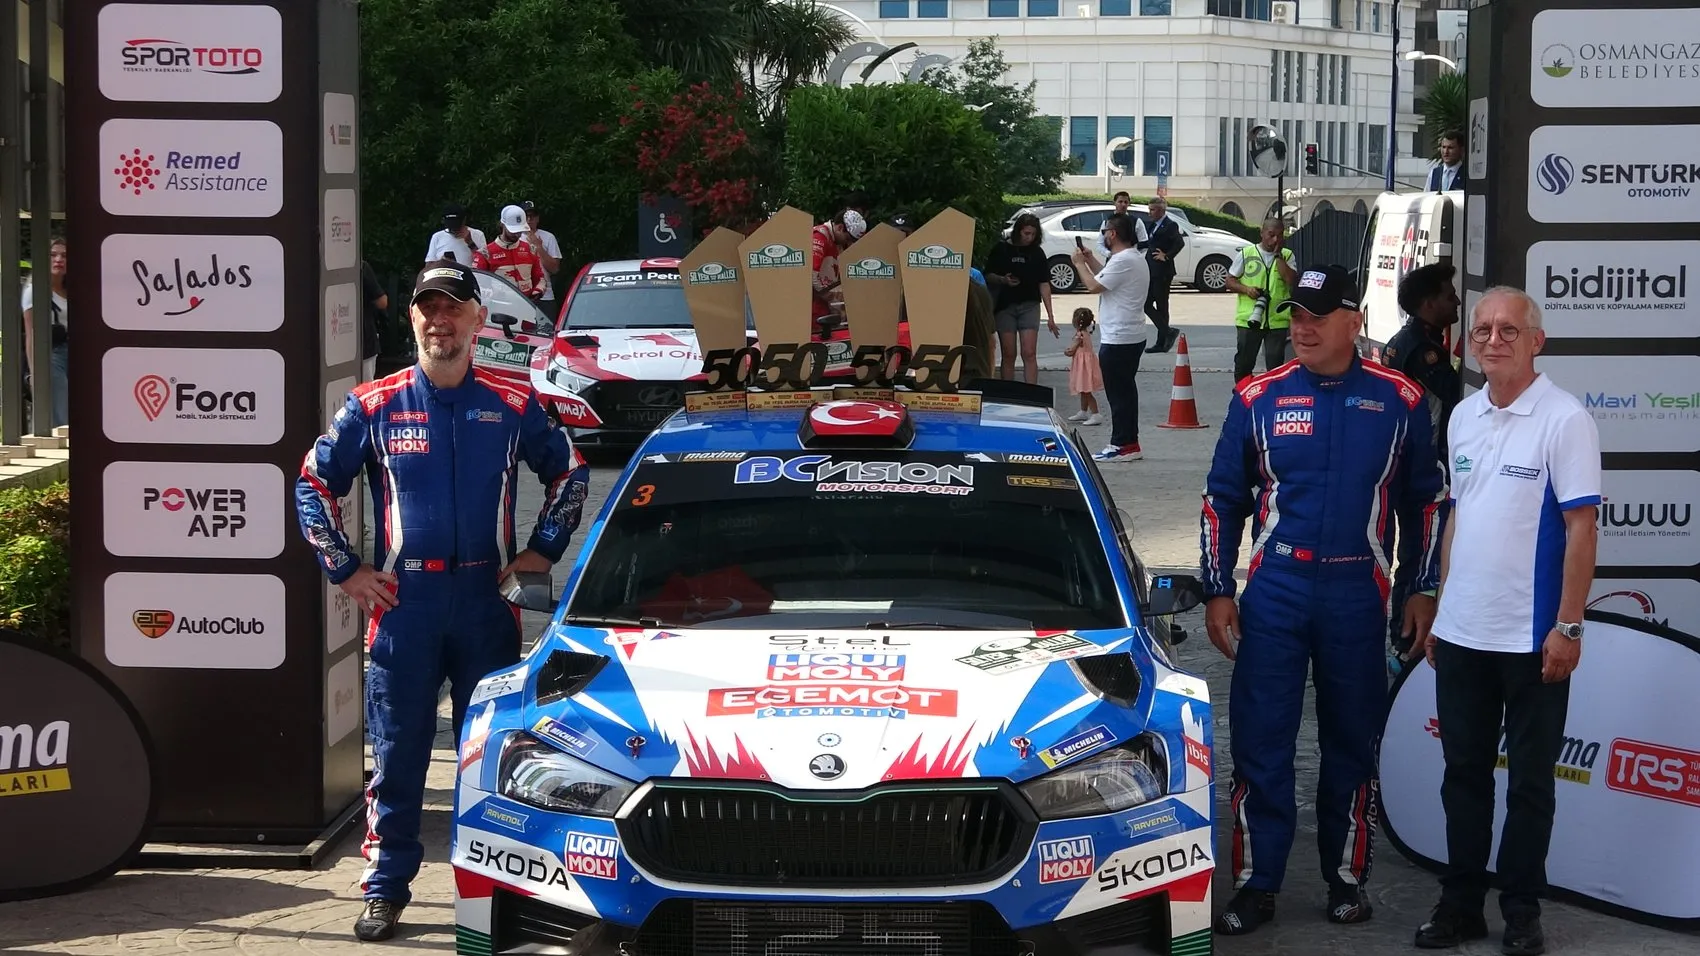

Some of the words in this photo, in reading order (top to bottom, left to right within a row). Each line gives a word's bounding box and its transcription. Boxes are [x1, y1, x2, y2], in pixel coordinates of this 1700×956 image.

[1580, 43, 1700, 60] OSMANGAZ
[1580, 63, 1700, 79] BELEDİYES
[166, 151, 241, 170] Remed
[165, 173, 268, 191] Assistance
[1628, 186, 1690, 198] OTOMOTİV
[132, 254, 252, 307] Salados
[594, 274, 643, 283] Team
[647, 272, 681, 280] Petr
[1545, 265, 1686, 302] bidijital
[608, 351, 663, 361] Petrol
[669, 350, 703, 360] Ofis
[176, 383, 256, 412] Fora
[1586, 392, 1636, 408] Mavi
[1644, 392, 1700, 410] Yeşil
[1276, 411, 1311, 422] LIQUI
[1592, 411, 1700, 420] anışmanlık
[391, 428, 427, 440] LIQUI
[1276, 422, 1311, 434] MOLY
[391, 440, 428, 452] MOLY
[684, 451, 746, 460] maxima
[1008, 454, 1067, 464] maxima
[631, 484, 656, 506] 3
[816, 482, 974, 496] MOTORSPORT
[143, 487, 246, 512] POWER
[1595, 496, 1691, 527] iwuu
[188, 514, 246, 537] APP
[1276, 543, 1292, 554] OMP
[404, 561, 422, 569] OMP
[177, 616, 264, 635] AutoClub
[774, 654, 904, 667] LIQUI
[773, 666, 901, 680] MOLY
[723, 687, 944, 708] EGEMOT
[0, 720, 70, 770] ma
[550, 727, 587, 750] MICHELIN
[1063, 732, 1105, 755] MICHELIN
[1188, 744, 1210, 767] ibis
[1560, 735, 1601, 769] ma
[1557, 767, 1581, 781] LARI
[1615, 749, 1687, 792] TRS
[486, 808, 523, 826] RAVENOL
[1133, 814, 1174, 832] RAVENOL
[569, 834, 616, 858] LIQUI
[1042, 838, 1091, 861] LIQUI
[568, 855, 615, 878] MOLY
[1043, 858, 1093, 881] MOLY
